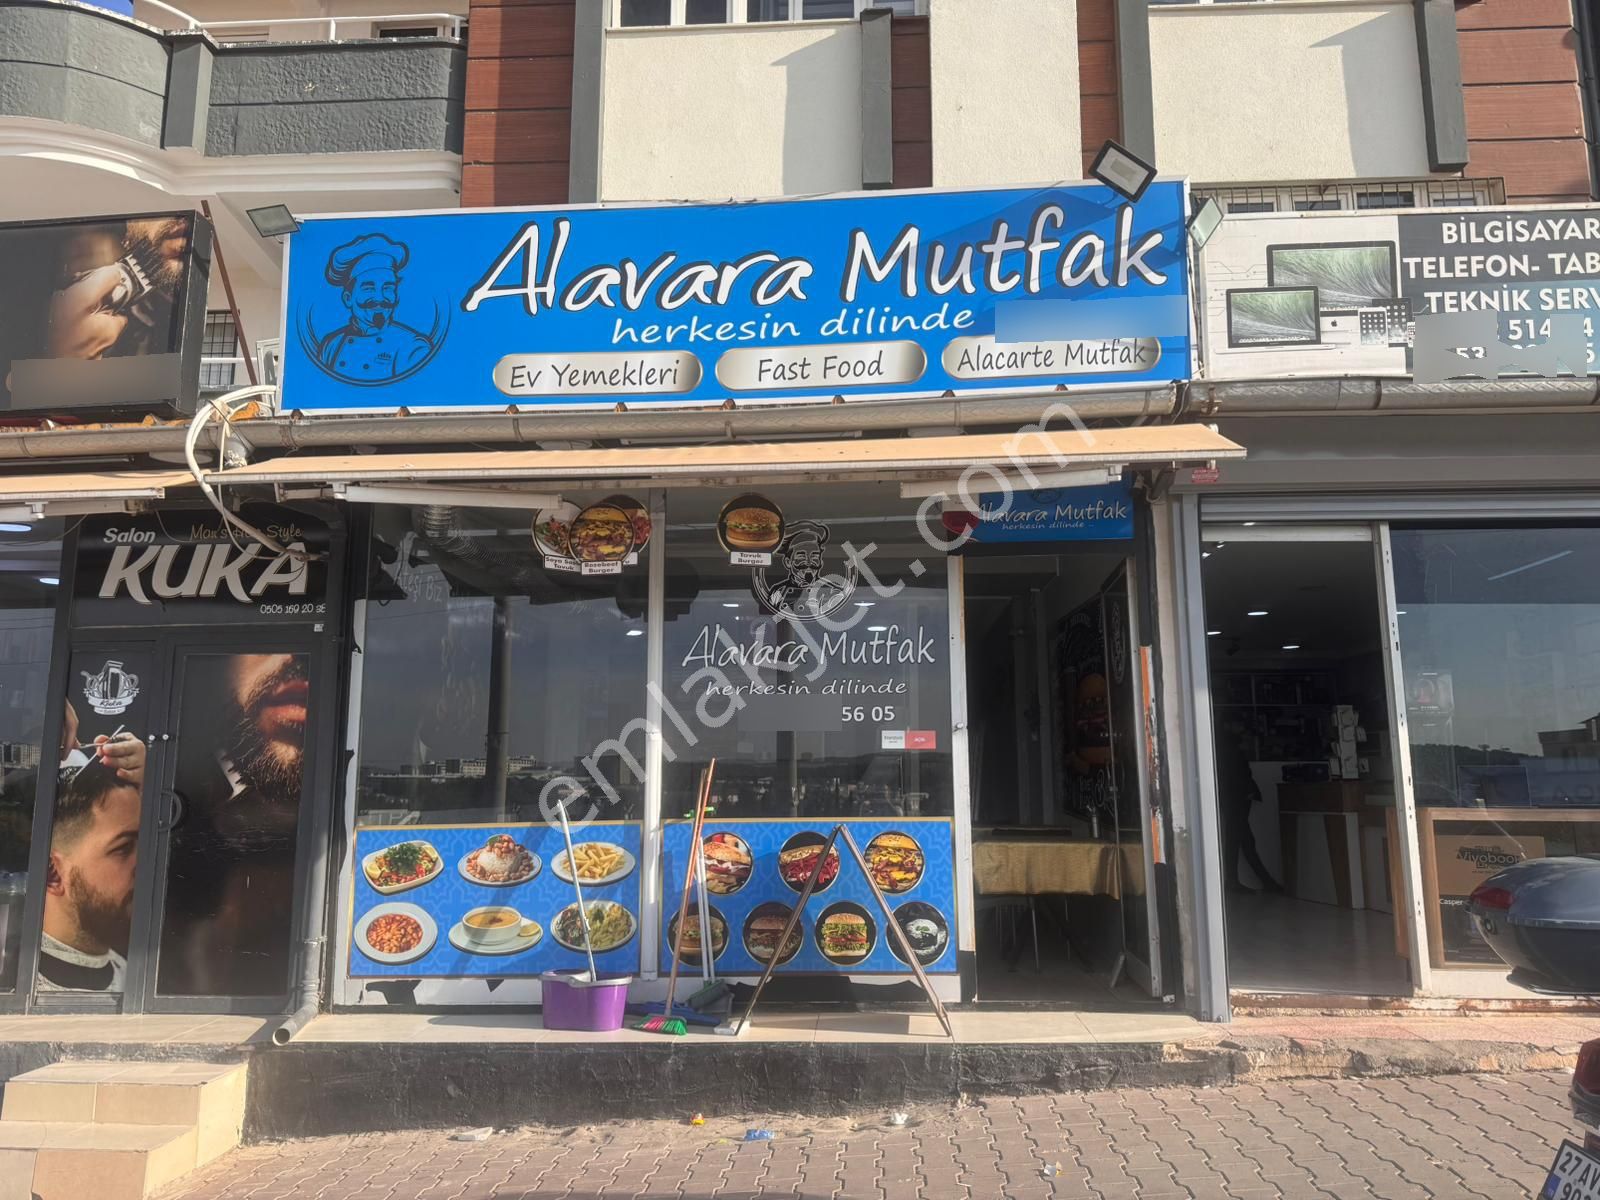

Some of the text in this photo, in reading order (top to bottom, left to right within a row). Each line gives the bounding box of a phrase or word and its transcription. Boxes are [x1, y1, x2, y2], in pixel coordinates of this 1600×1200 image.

[1442, 215, 1600, 244] BİLGİSAYAR
[461, 202, 1168, 317] Alavara Mutfak
[1547, 252, 1600, 275] TAB
[1424, 284, 1531, 314] TEKNİK
[612, 302, 975, 344] herkesin dilinde
[758, 350, 884, 382] Fast Food
[957, 339, 1147, 372] Alacarte Mutfak
[510, 360, 681, 388] Ev Yemekleri
[1054, 500, 1127, 521] Mutfak
[103, 527, 156, 544] Salon
[266, 522, 303, 542] Style
[98, 542, 309, 605] KUKA
[260, 603, 283, 614] 0505
[681, 623, 936, 668] Alavara Mutfak
[705, 678, 908, 696] herkesin dilinde
[841, 705, 895, 722] 56 05
[1559, 1151, 1600, 1196] 27 AV
[1560, 1182, 1591, 1200] 90
